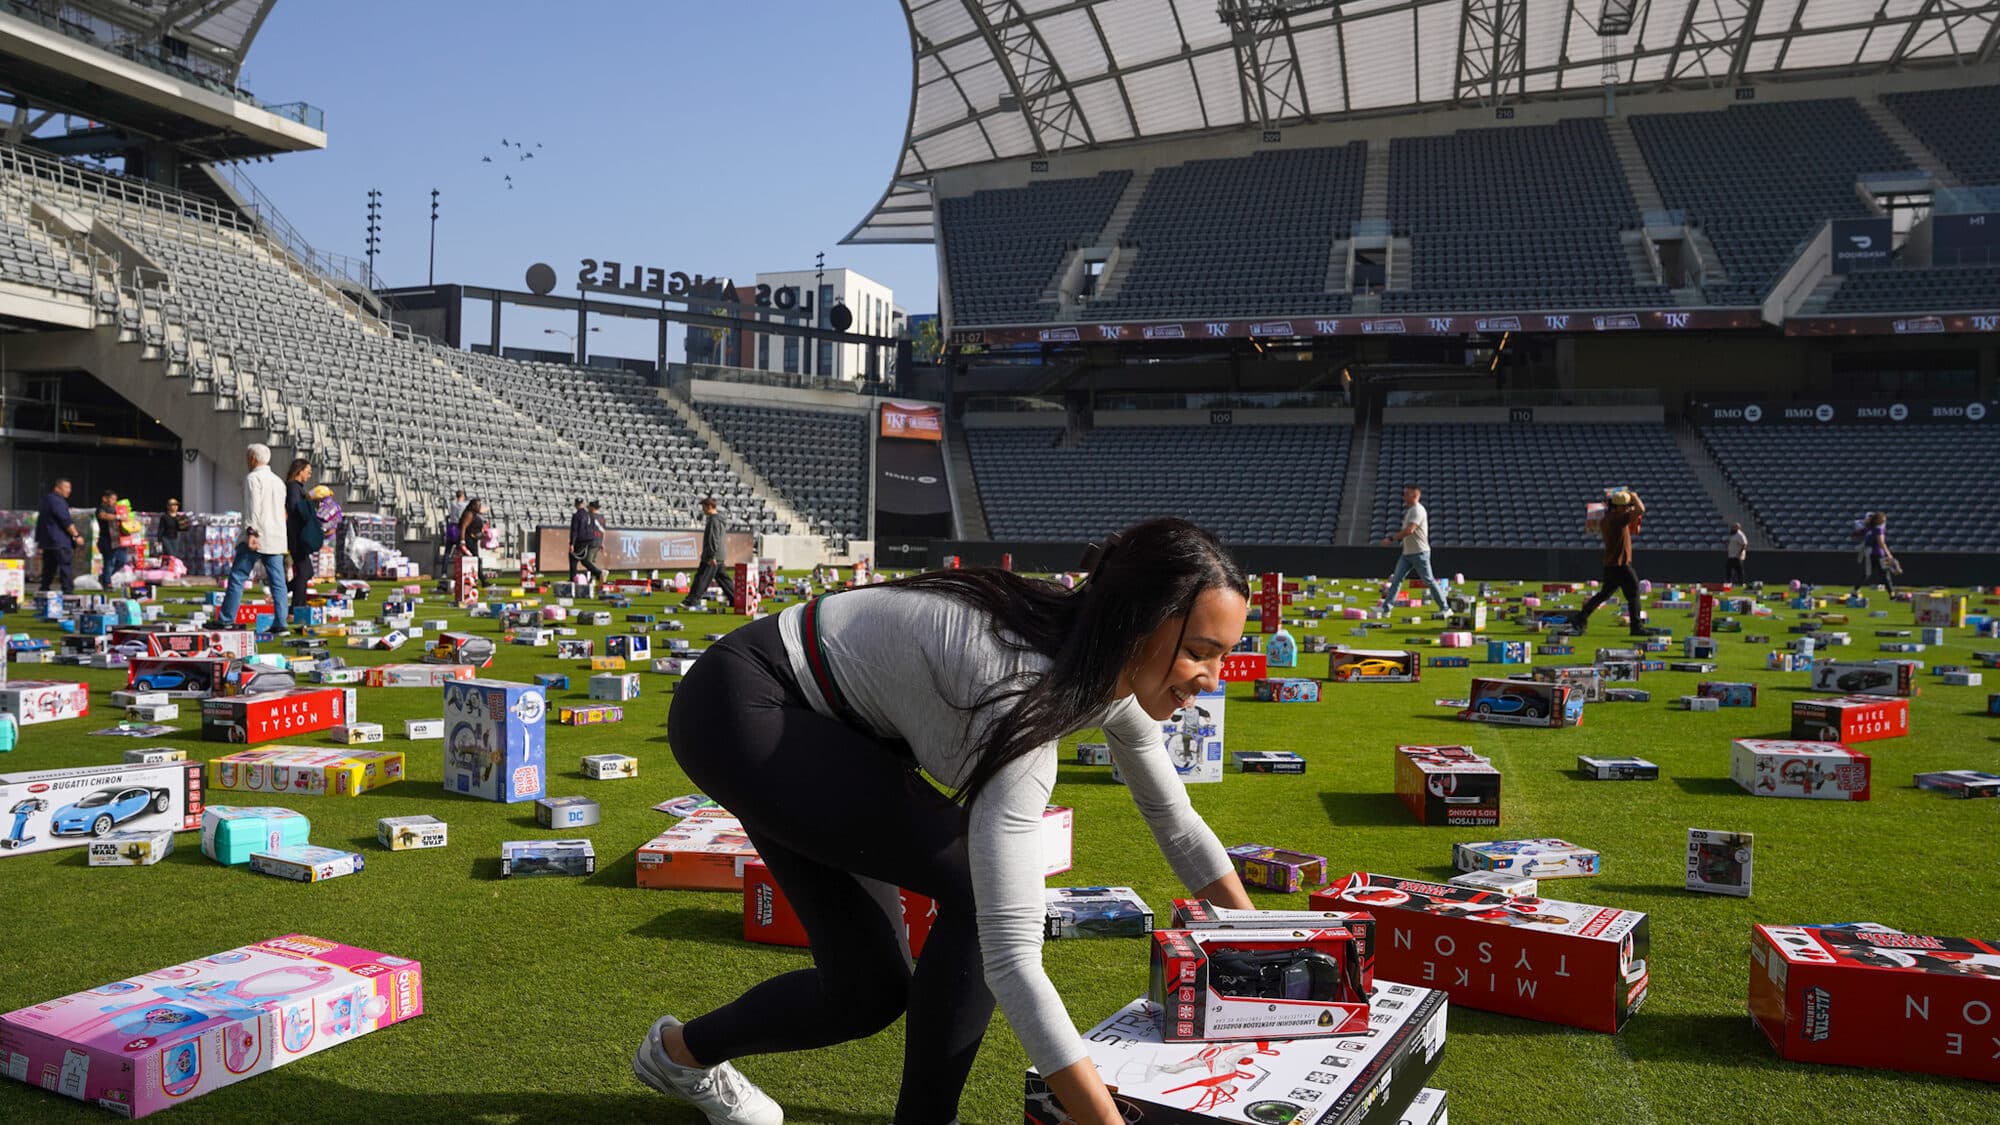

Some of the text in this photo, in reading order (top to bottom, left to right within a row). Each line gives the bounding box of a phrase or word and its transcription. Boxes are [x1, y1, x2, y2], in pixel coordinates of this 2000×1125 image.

[1512, 411, 1530, 420] 110
[1714, 409, 1742, 419] BMO
[1785, 408, 1813, 418] BMO
[1857, 408, 1887, 418] BMO
[1933, 407, 1964, 417] BMO
[1213, 414, 1230, 423] 109
[271, 702, 309, 717] MIKE
[1857, 710, 1884, 722] MIKE
[261, 712, 318, 732] TYSON
[1850, 721, 1890, 735] TYSON
[52, 778, 89, 790] BUGATTI
[90, 776, 122, 787] CHIRON
[568, 811, 583, 822] DC
[1394, 927, 1570, 977] TYSON
[1423, 962, 1538, 999] MIKE
[398, 972, 411, 1017] QUEEN
[1211, 1005, 1222, 1013] 6+
[1813, 986, 1830, 1042] ALL-STAR
[1213, 1023, 1243, 1031] ROADSTER
[1276, 1018, 1316, 1026] LAMBORGHINI
